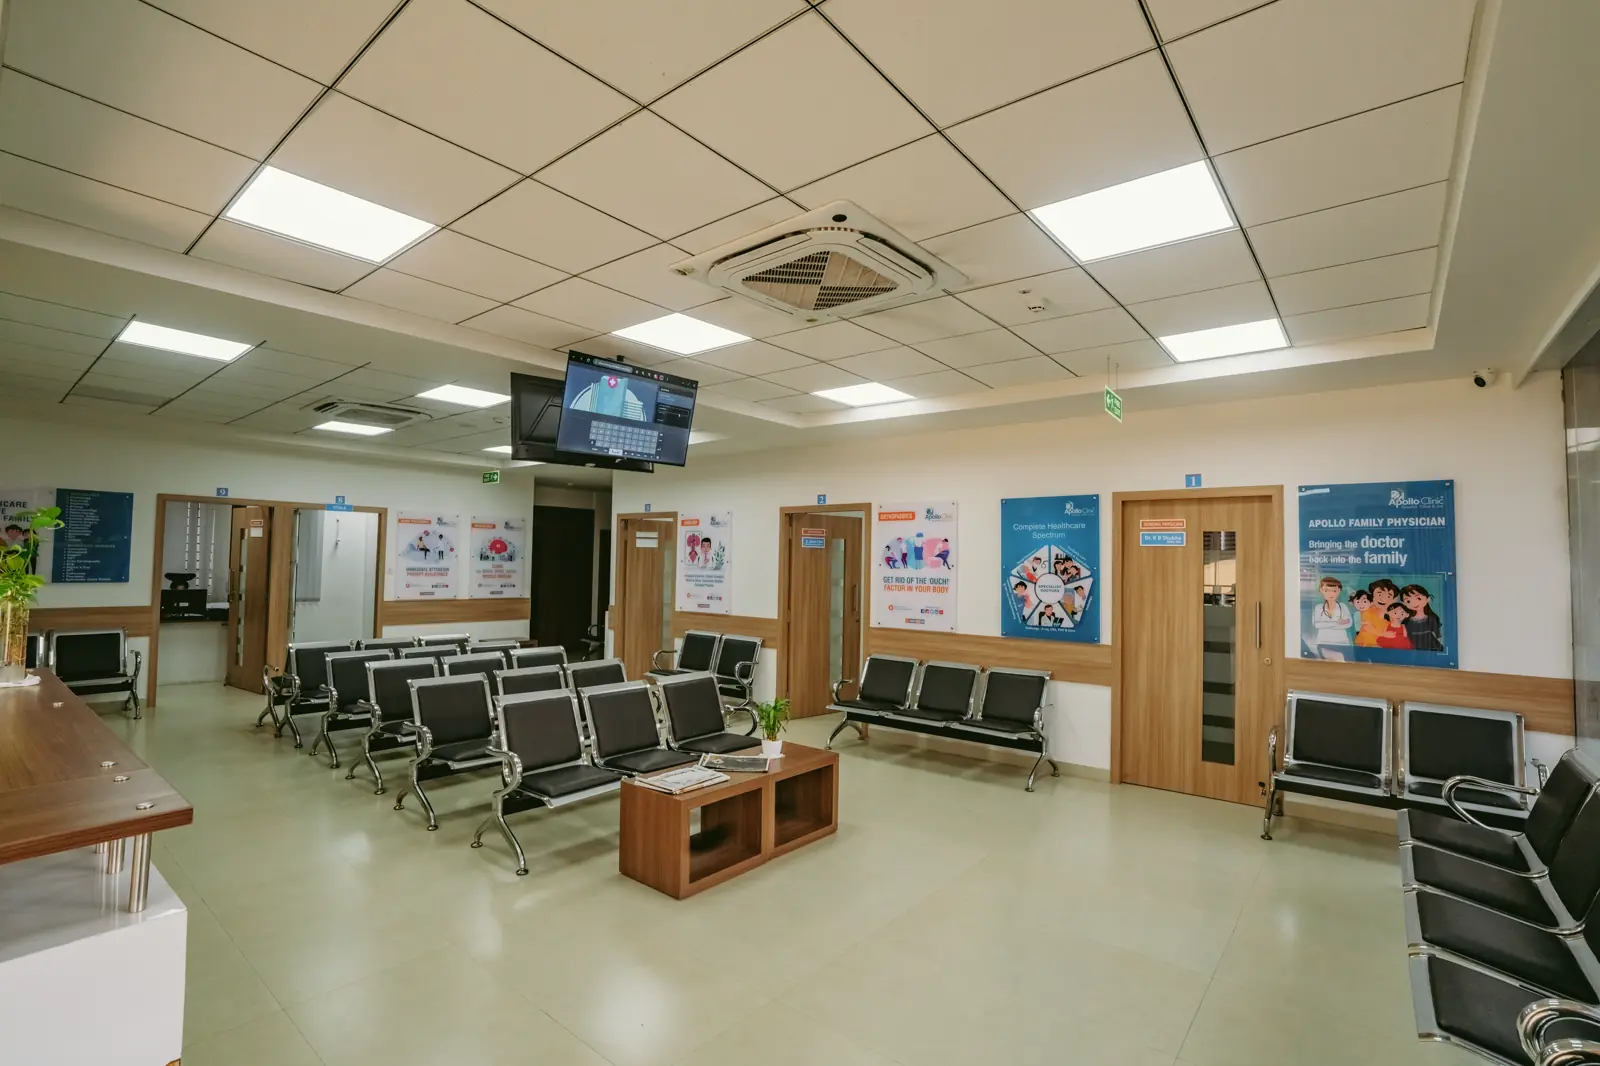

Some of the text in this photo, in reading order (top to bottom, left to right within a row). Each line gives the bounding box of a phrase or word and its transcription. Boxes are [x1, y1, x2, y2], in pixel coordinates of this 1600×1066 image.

[1190, 476, 1196, 486] 1
[1388, 497, 1420, 508] Apollo
[1420, 496, 1444, 505] Clinic
[1013, 523, 1045, 531] Complete
[1308, 517, 1446, 528] APOLLO FAMILY PHYSICIAN
[1032, 531, 1066, 540] Spectrum
[1309, 536, 1405, 550] Bringing the doctor
[1309, 551, 1408, 566] back into the family
